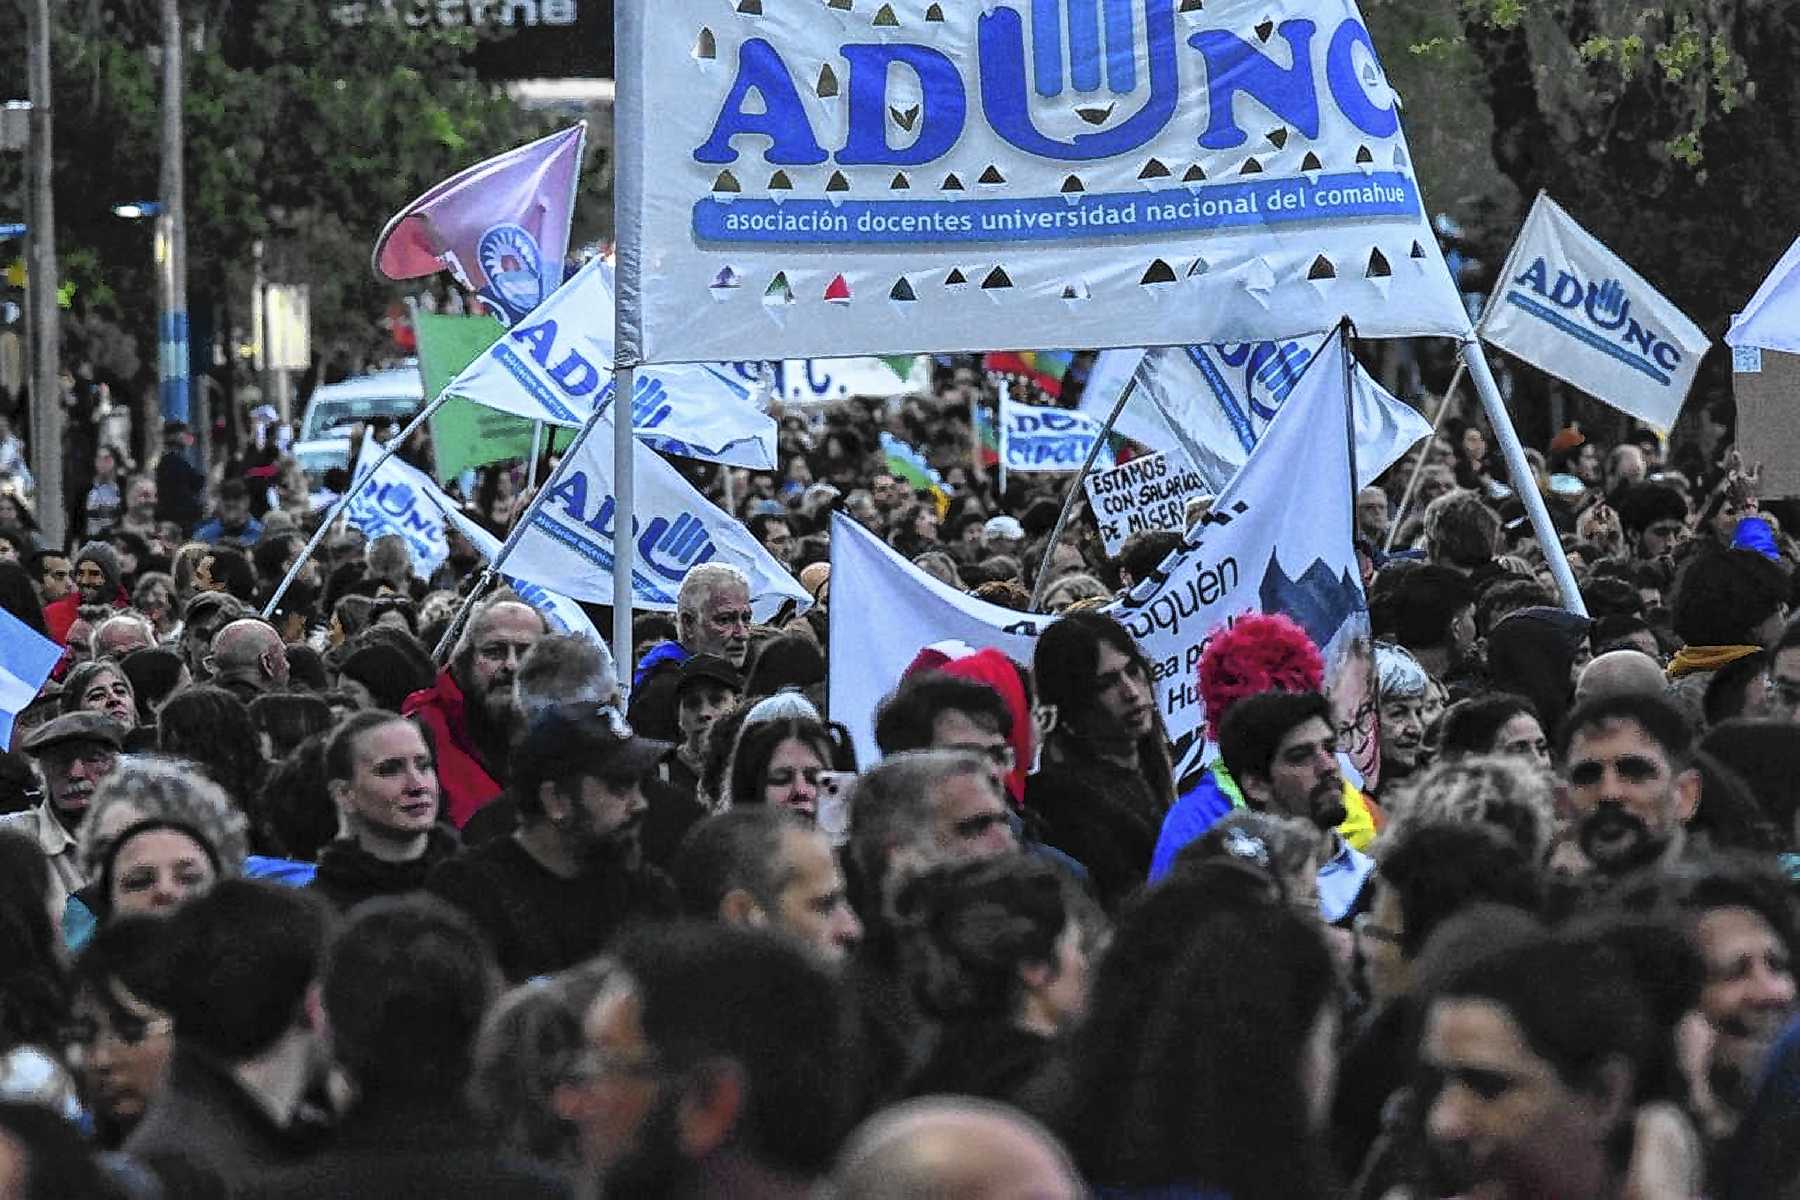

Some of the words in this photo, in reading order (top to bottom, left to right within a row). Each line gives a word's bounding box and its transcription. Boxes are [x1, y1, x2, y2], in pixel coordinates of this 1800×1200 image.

[693, 0, 1398, 165] ADUNC
[725, 210, 848, 232] asociación
[857, 211, 972, 232] docentes
[982, 203, 1137, 230] universidad
[1147, 191, 1258, 222] nacional
[1267, 188, 1305, 212] del
[1315, 182, 1405, 208] comahue
[1513, 256, 1681, 371] ADUNC
[1092, 454, 1167, 495] ESTAMOS
[1100, 520, 1122, 541] DE
[1127, 497, 1185, 533] MISERI
[1103, 489, 1136, 515] CON
[1125, 556, 1239, 638] uquén
